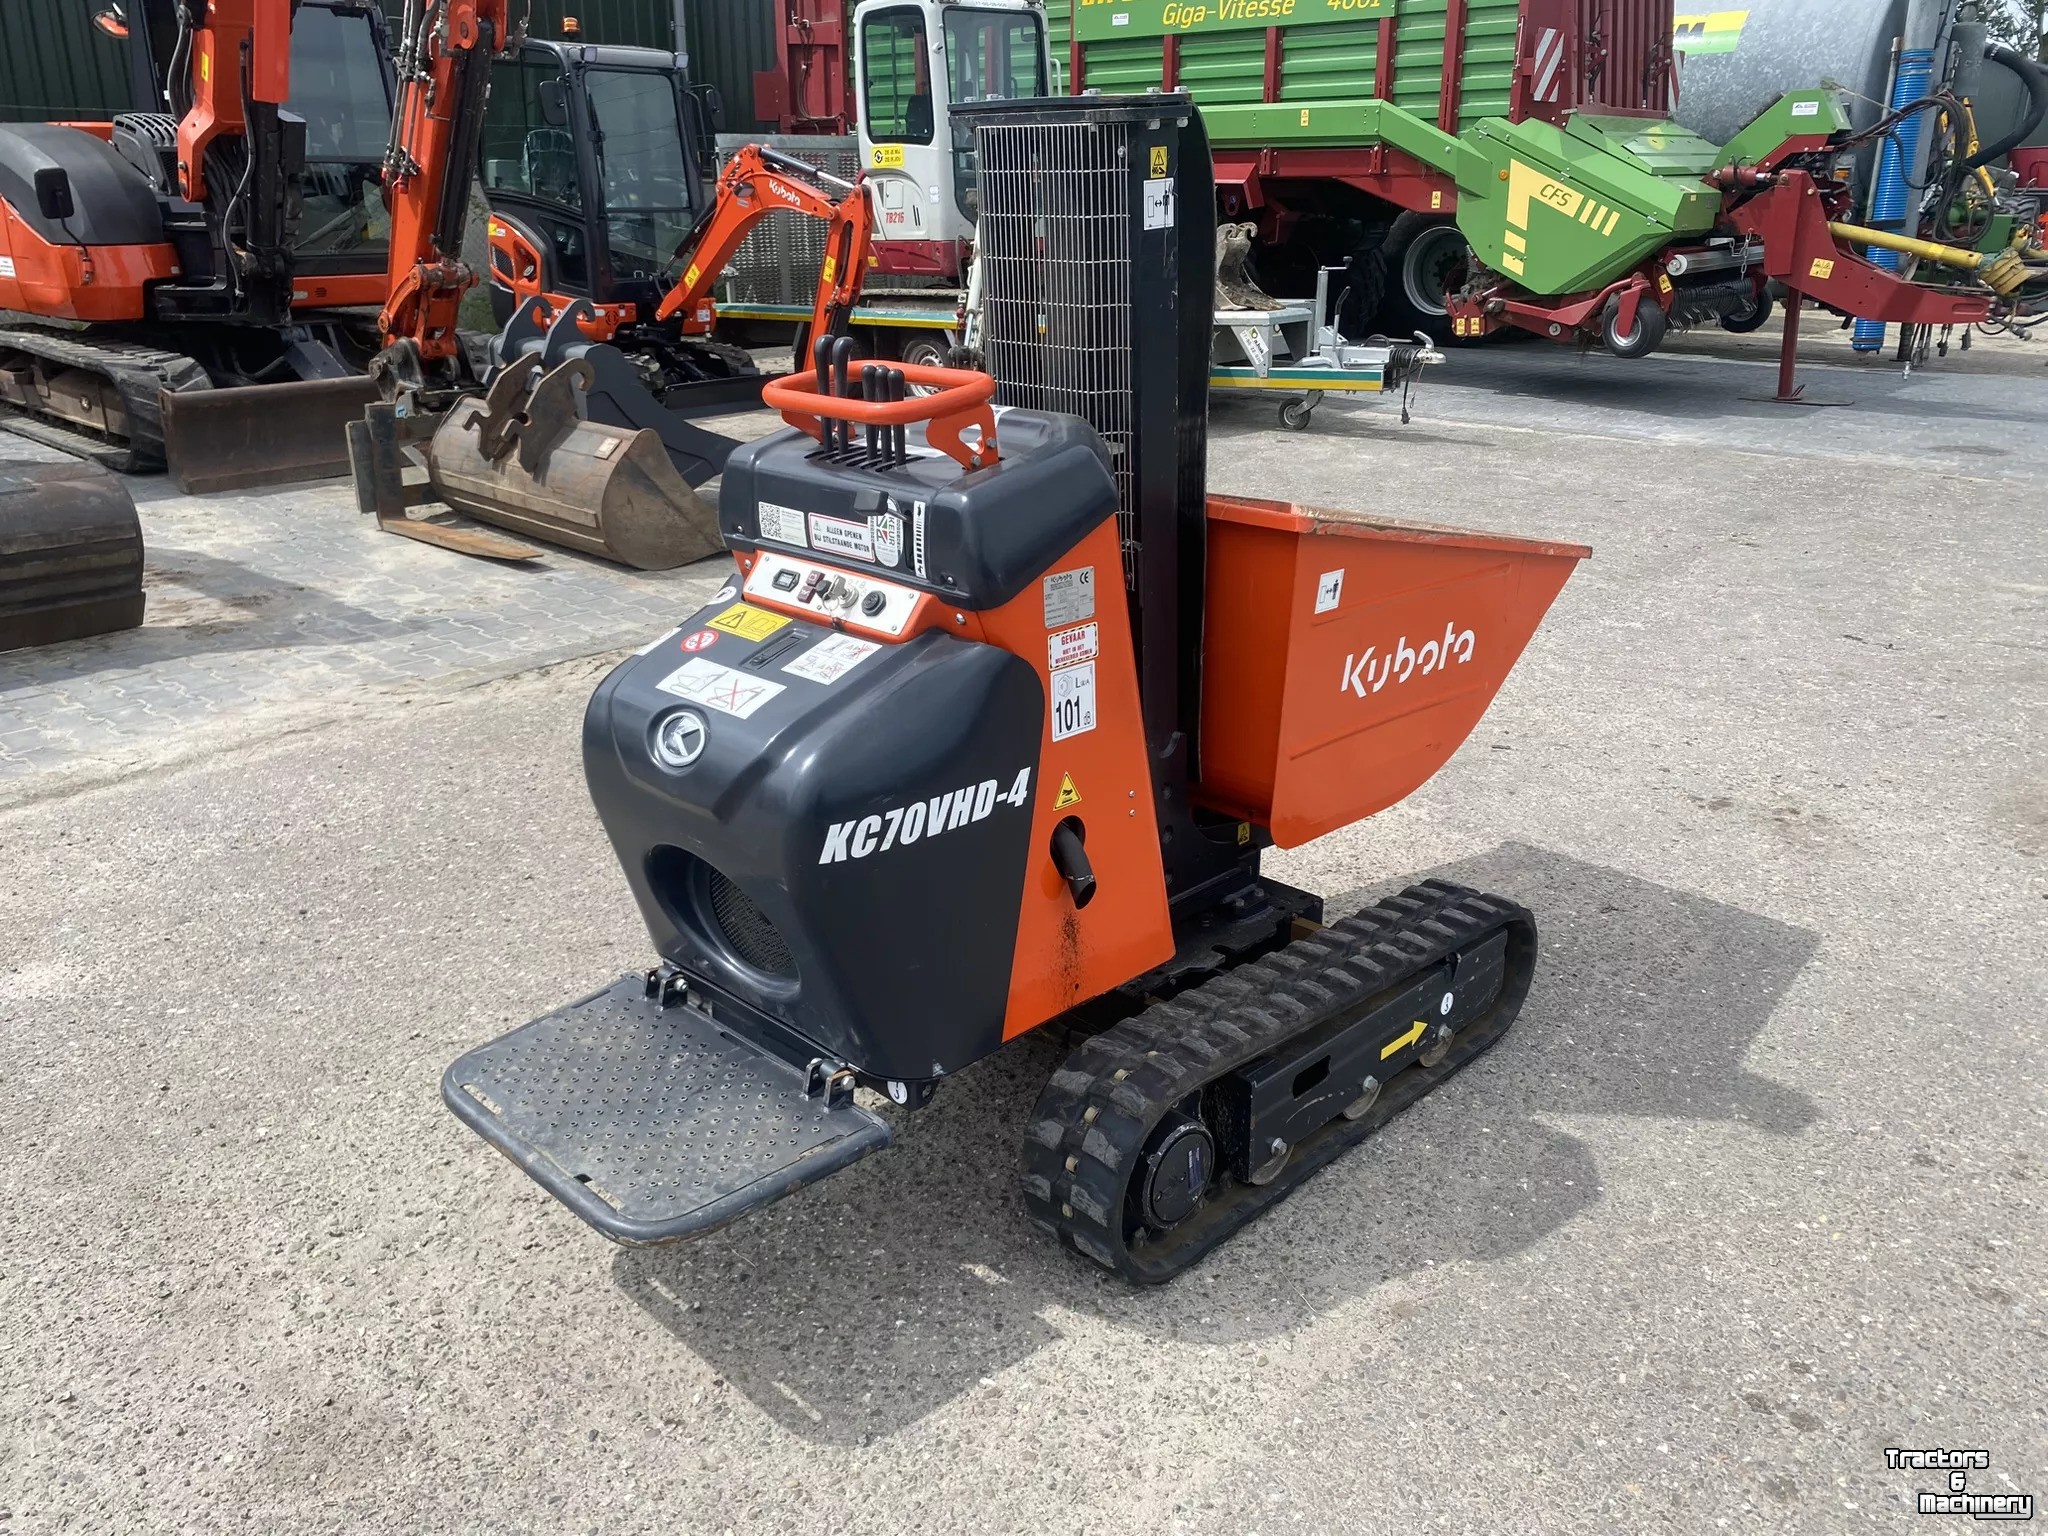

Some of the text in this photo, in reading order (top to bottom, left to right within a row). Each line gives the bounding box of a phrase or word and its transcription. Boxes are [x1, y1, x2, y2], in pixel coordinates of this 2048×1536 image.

[1162, 0, 1296, 28] Giga-Vitesse
[769, 180, 801, 206] Kubota
[1540, 184, 1572, 206] CFS
[844, 530, 863, 540] OPENEN
[854, 542, 870, 552] MOTOR
[1061, 630, 1086, 645] GEVAAR
[1340, 621, 1475, 698] Kubota
[1056, 695, 1080, 734] 101
[818, 766, 1032, 865] KC70VHD-4
